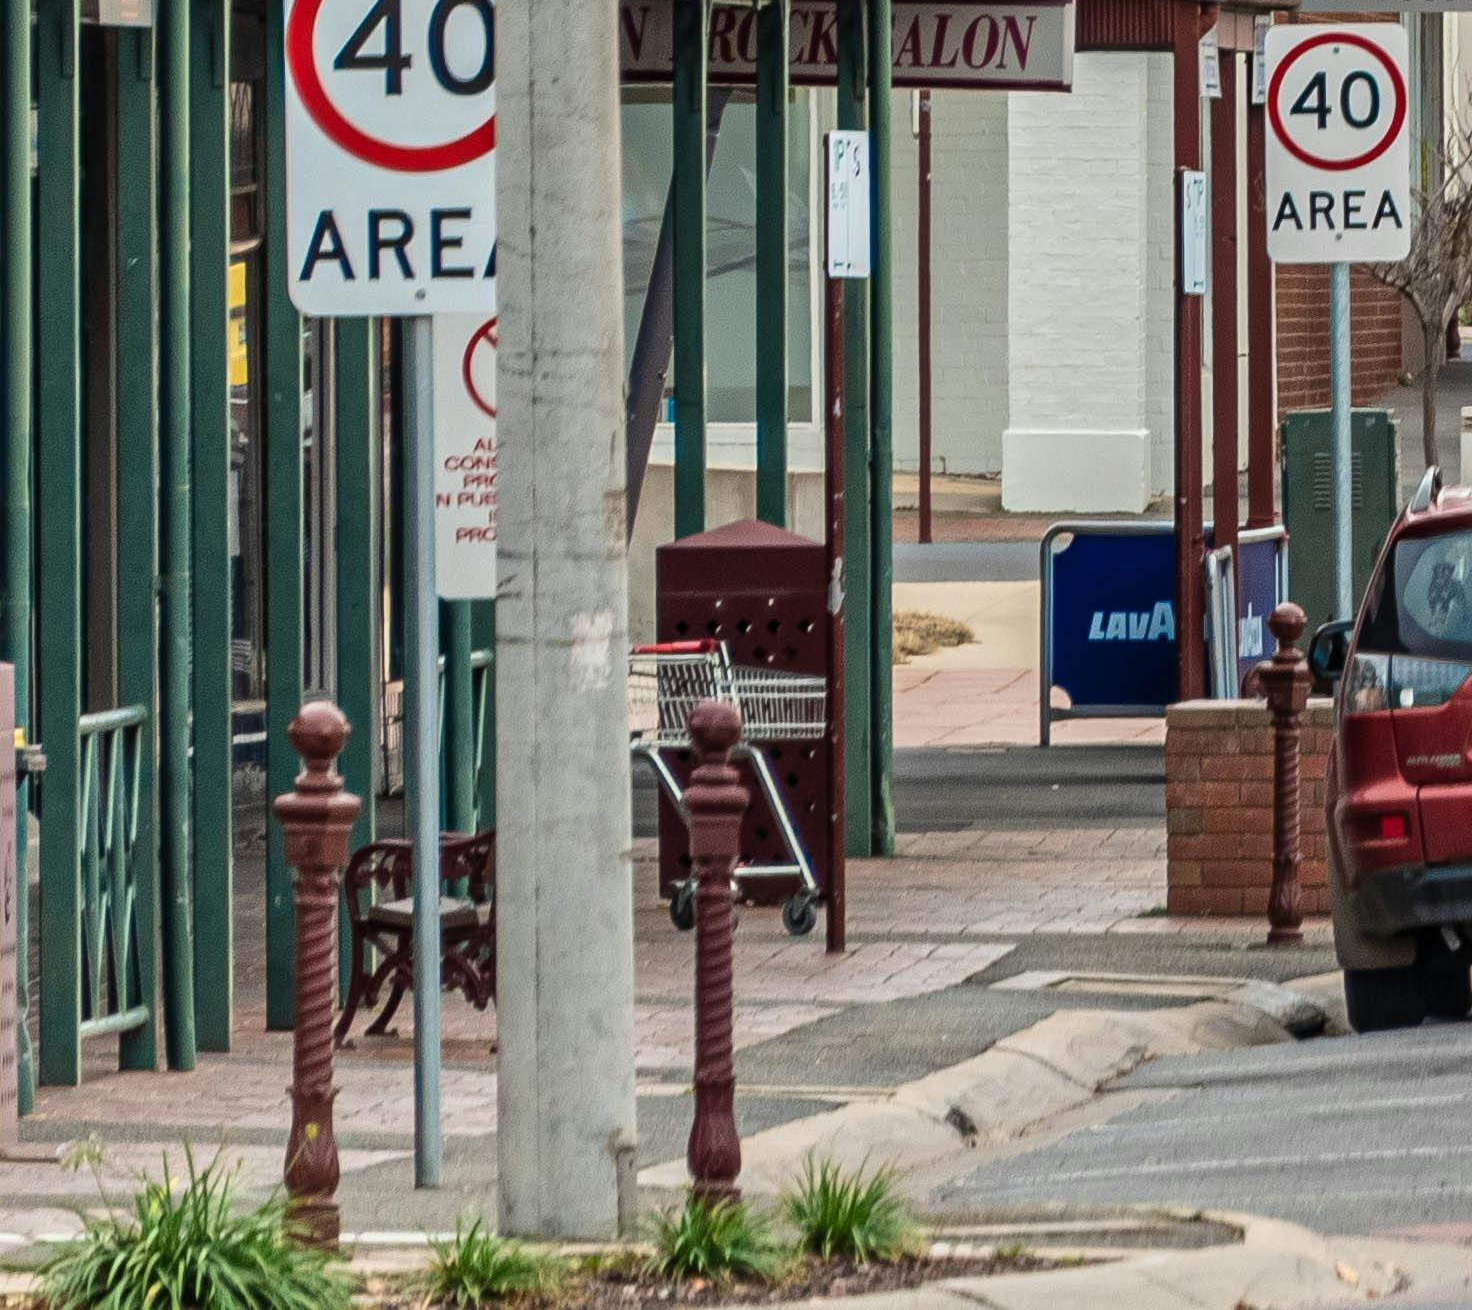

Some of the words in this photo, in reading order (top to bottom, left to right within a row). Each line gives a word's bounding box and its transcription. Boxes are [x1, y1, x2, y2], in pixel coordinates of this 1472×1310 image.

[891, 13, 1037, 70] ALON
[1289, 70, 1380, 130] 40
[1272, 189, 1404, 231] AREA
[298, 207, 496, 282] ARE
[1088, 601, 1176, 641] LAVA
